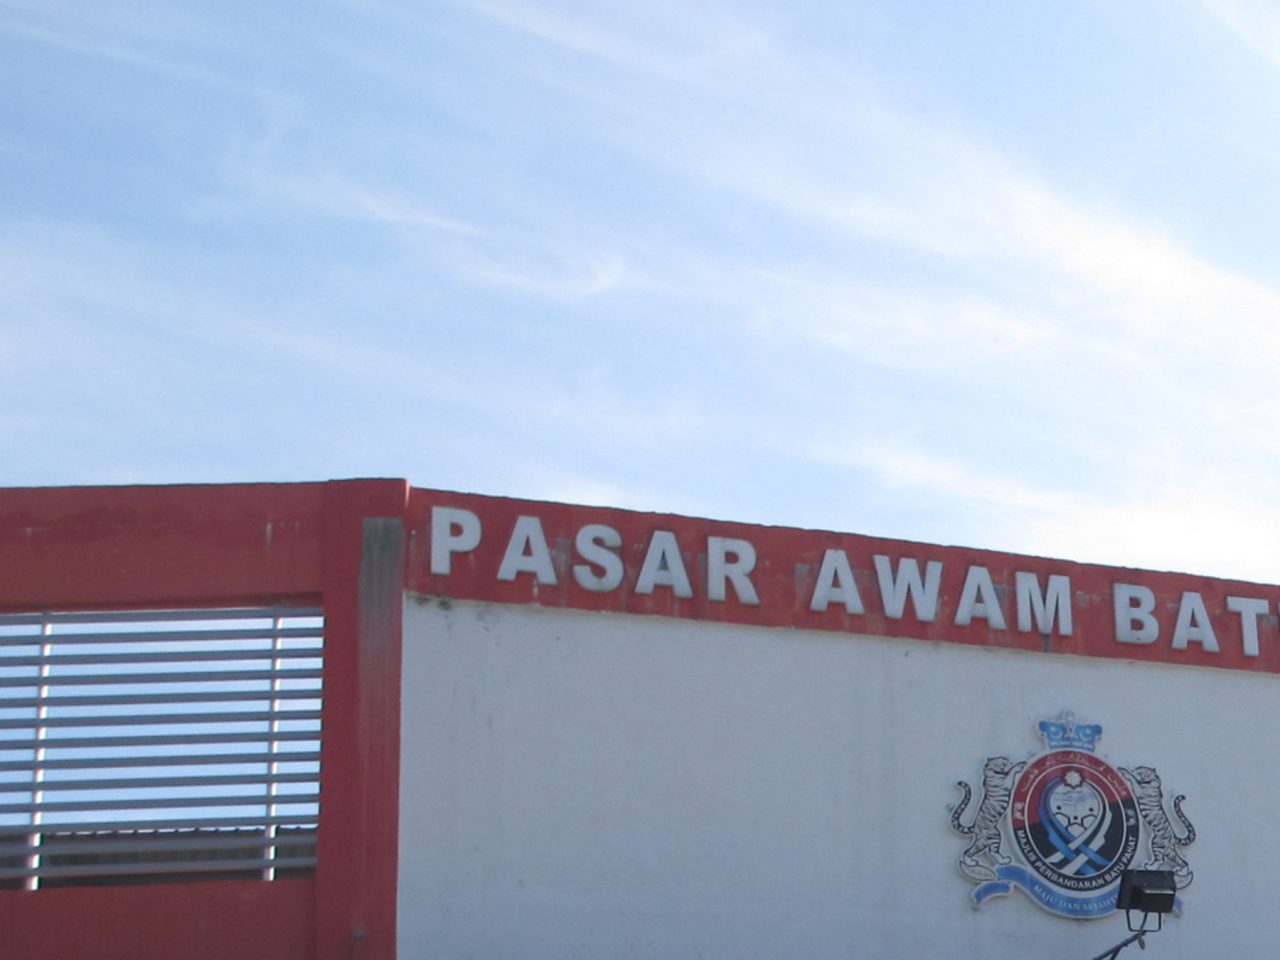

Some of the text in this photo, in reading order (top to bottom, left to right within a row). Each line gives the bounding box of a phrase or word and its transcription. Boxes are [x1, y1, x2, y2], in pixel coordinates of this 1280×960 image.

[430, 506, 760, 605] PASAR
[810, 549, 1074, 637] AWAM
[1017, 831, 1136, 889] MAJLIS PERBANDARAN BATU PAHAT
